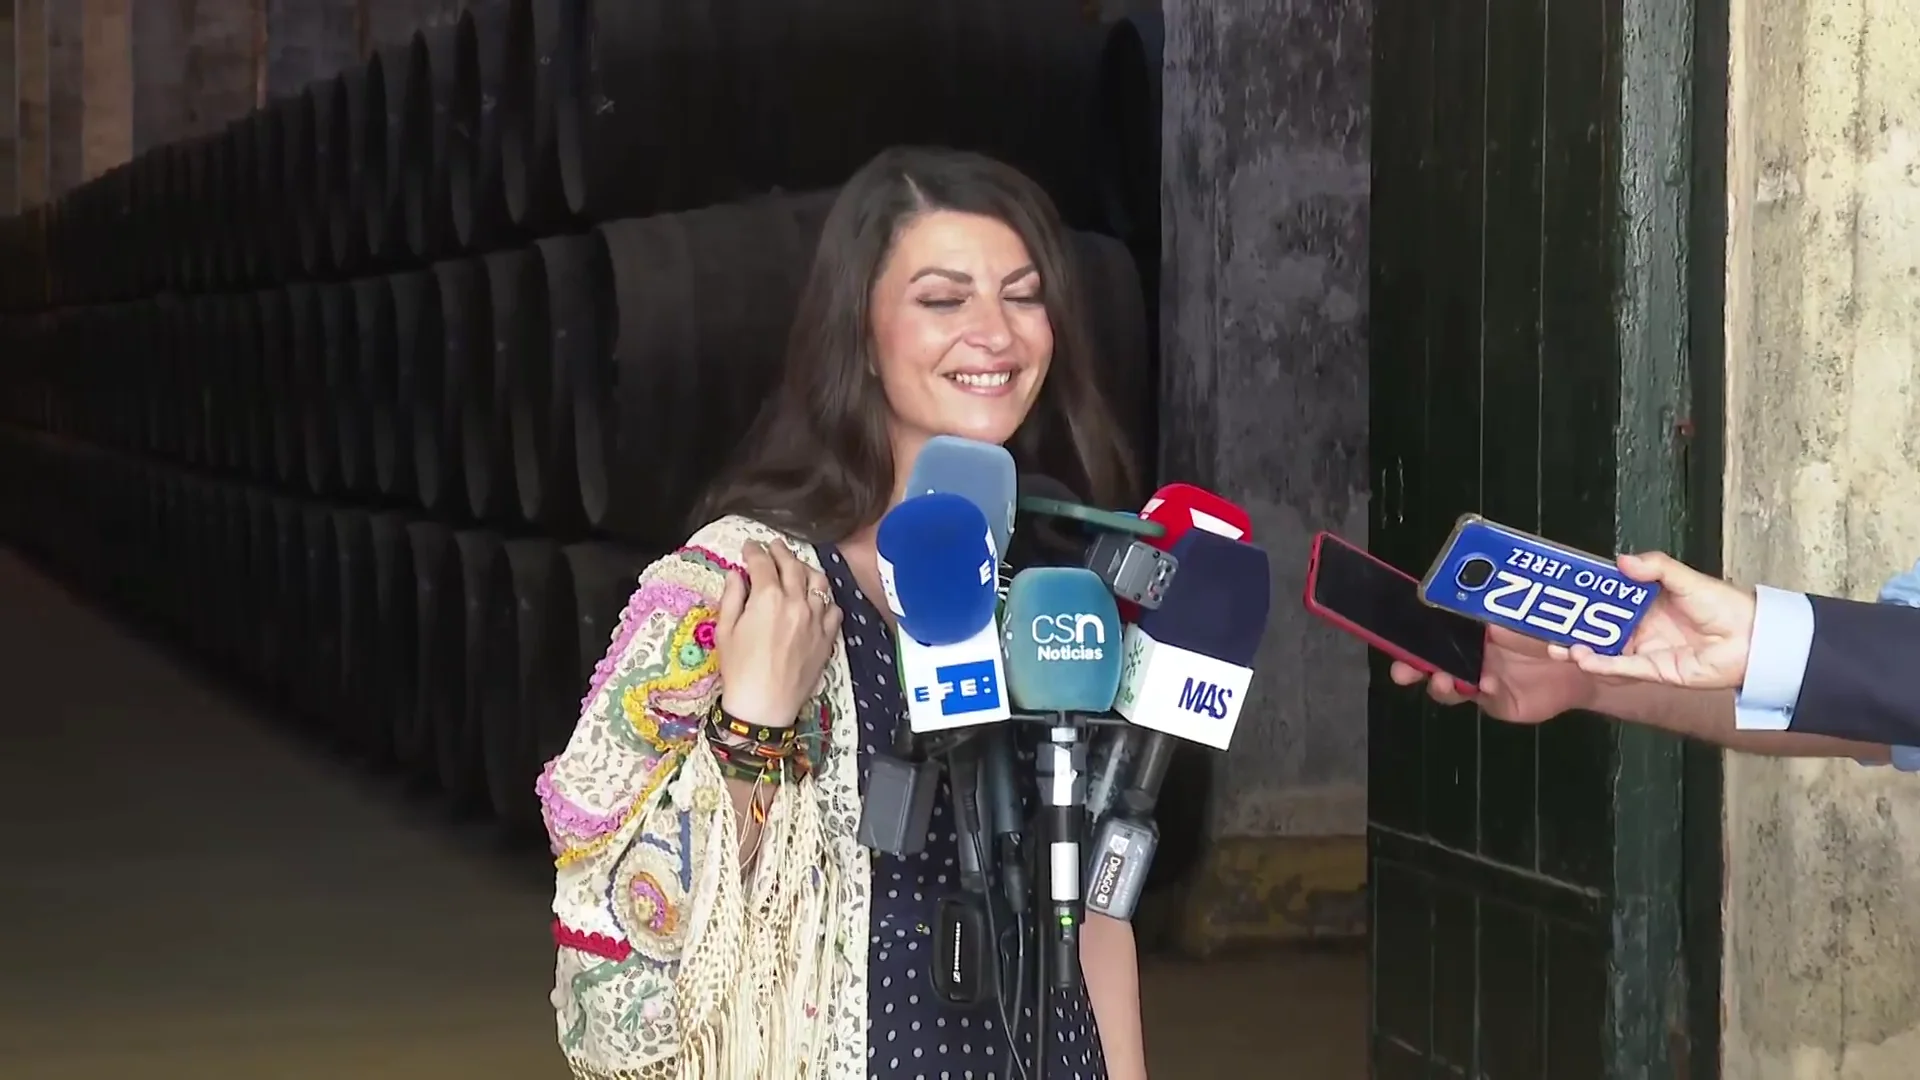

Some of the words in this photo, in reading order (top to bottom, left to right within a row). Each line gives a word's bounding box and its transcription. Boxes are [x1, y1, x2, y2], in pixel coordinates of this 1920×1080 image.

[1506, 549, 1570, 579] JEREZ
[1574, 571, 1647, 604] RADIO
[1483, 570, 1634, 647] SER
[1037, 644, 1103, 661] Noticias
